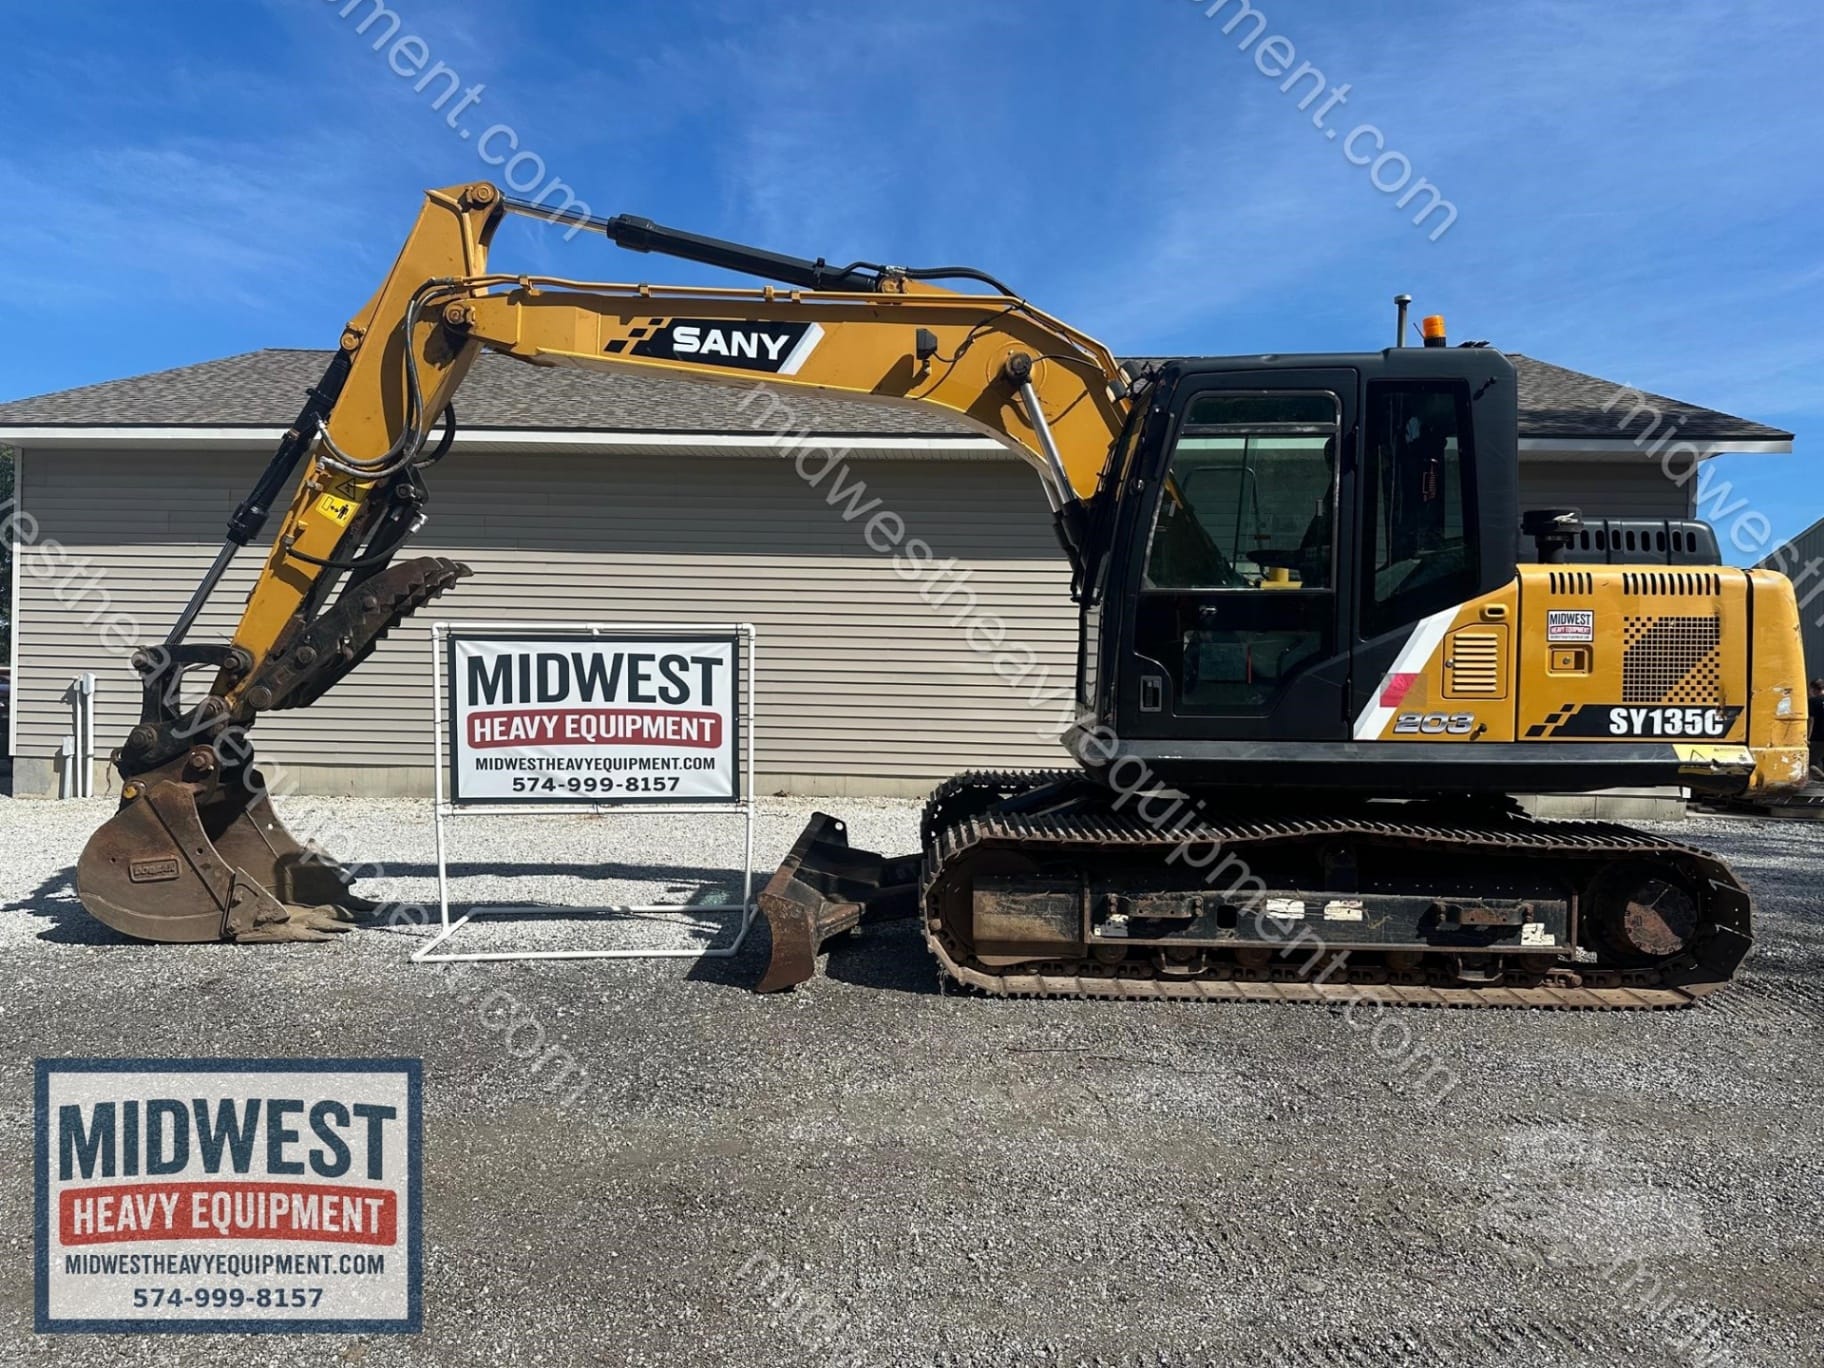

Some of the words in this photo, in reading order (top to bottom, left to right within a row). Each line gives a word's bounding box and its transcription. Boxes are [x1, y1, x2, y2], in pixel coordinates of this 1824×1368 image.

[672, 325, 790, 361] SANY
[1549, 612, 1592, 626] MIDWEST
[467, 652, 724, 707] MIDWEST
[473, 715, 559, 742] HEAVY
[565, 714, 716, 743] EQUIPMENT
[1392, 711, 1475, 735] 203
[475, 757, 716, 772] MIDWESTHEAVYEQUIPMENT.COM
[512, 776, 680, 793] 574-999-8157
